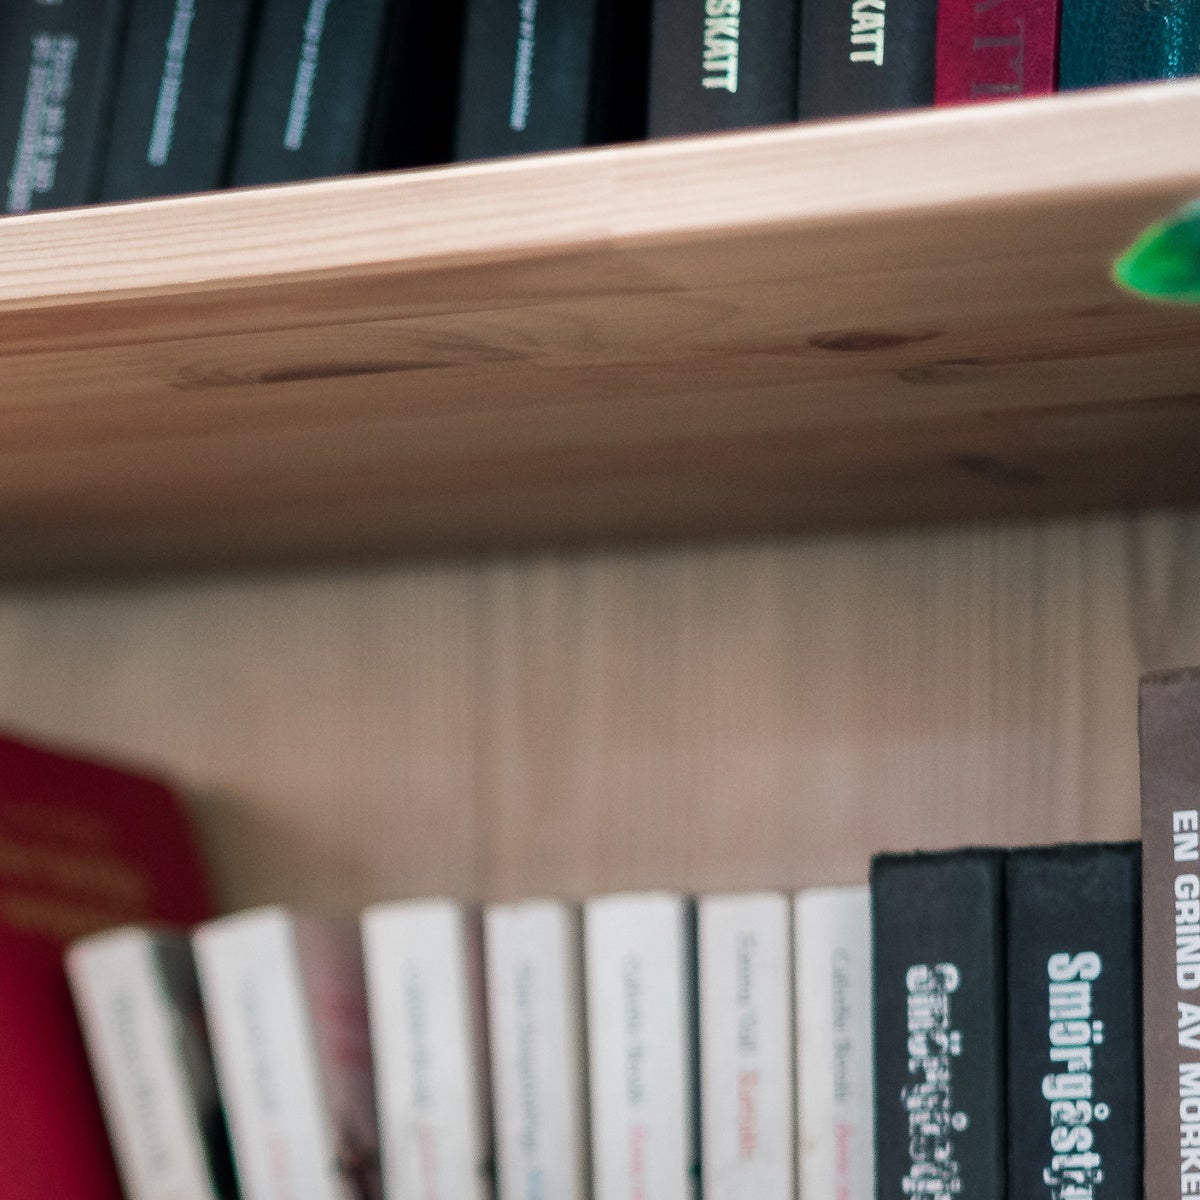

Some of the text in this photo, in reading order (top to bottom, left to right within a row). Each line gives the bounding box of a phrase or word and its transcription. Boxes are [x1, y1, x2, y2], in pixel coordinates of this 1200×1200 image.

[1173, 809, 1199, 862] EN
[1174, 872, 1200, 990] GRIND
[1177, 1001, 1200, 1050] AV
